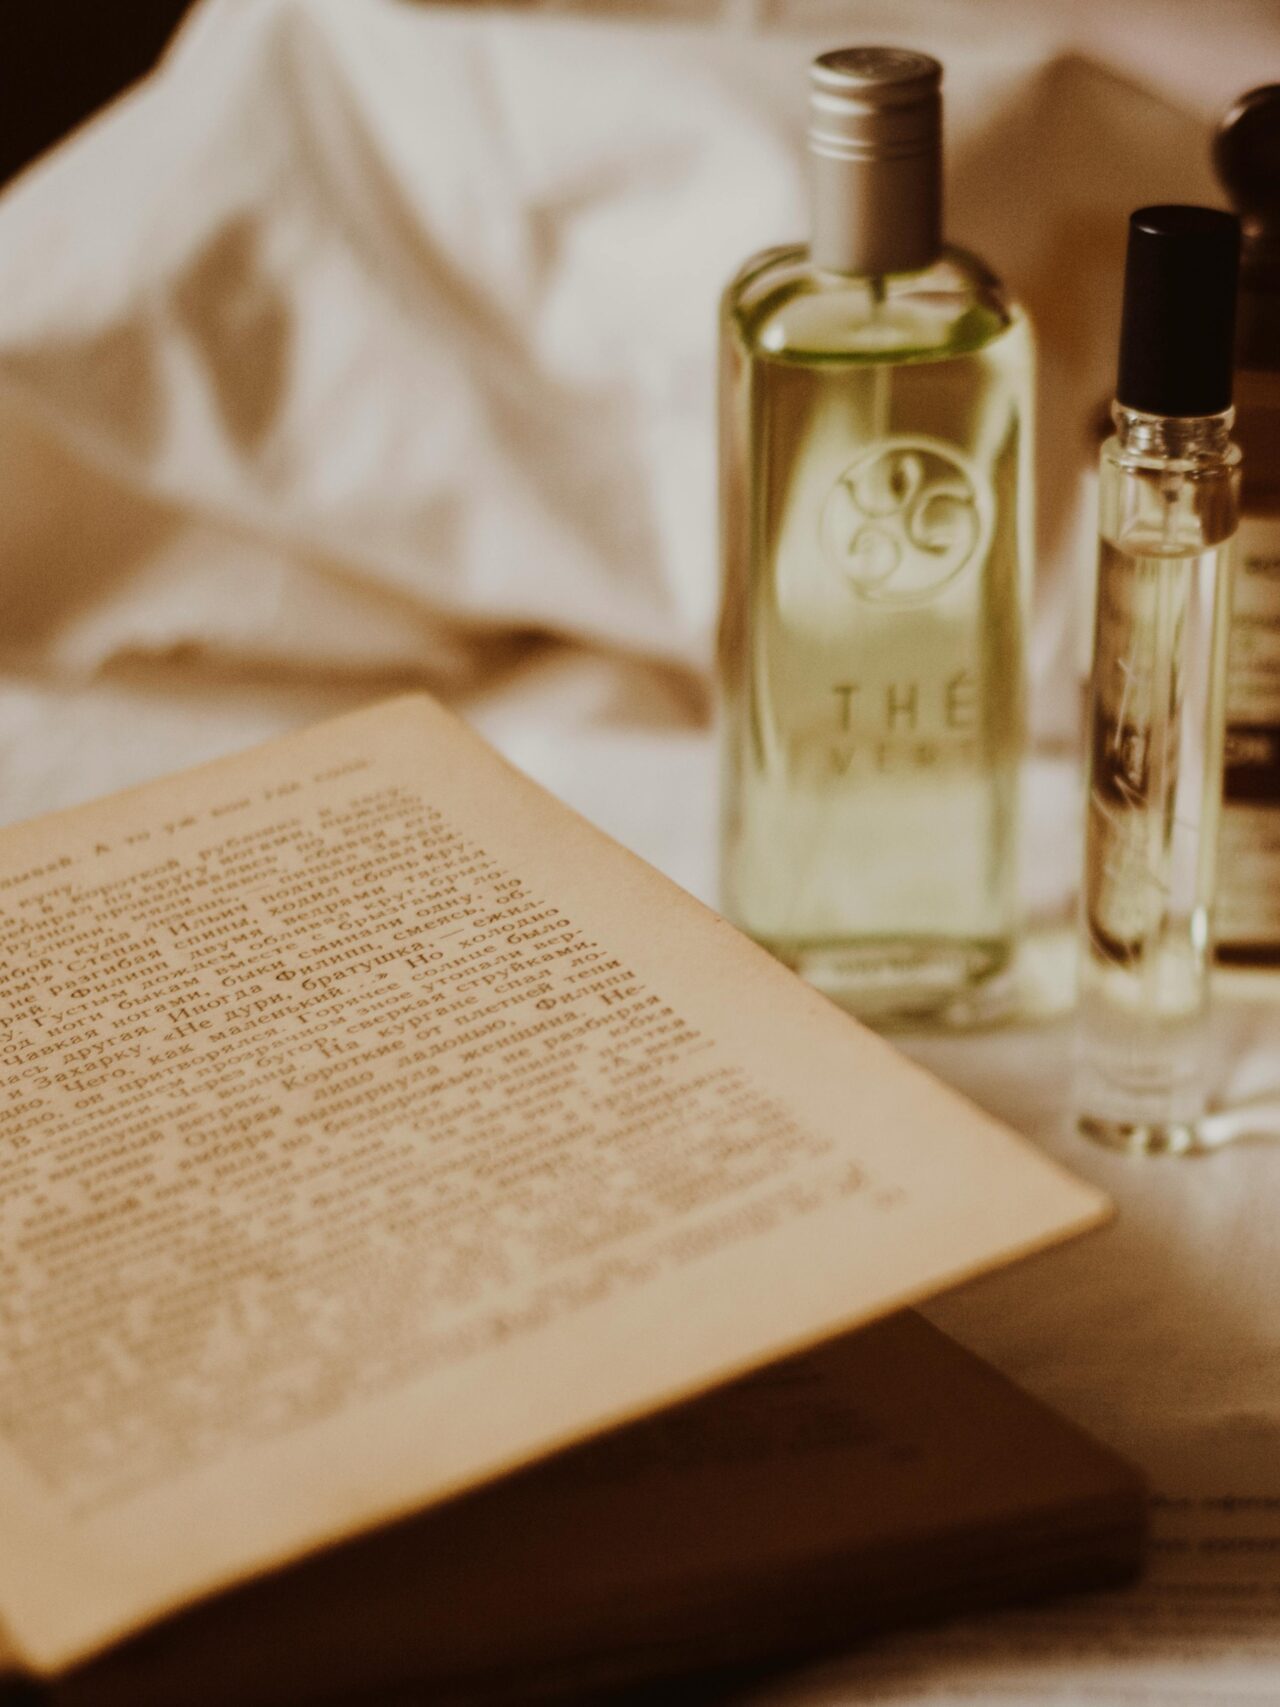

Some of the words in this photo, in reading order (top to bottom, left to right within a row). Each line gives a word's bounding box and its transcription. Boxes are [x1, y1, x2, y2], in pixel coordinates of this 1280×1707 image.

[832, 669, 979, 731] THÉ
[1, 1027, 100, 1066] Чавкая
[110, 989, 211, 1029] ногами,
[219, 958, 287, 988] быки
[296, 916, 404, 960] сминали
[492, 877, 522, 893] но
[30, 987, 129, 1028] Густым
[140, 950, 238, 991] дождем
[247, 910, 351, 951] обливал
[45, 1010, 104, 1038] ноги
[116, 975, 201, 1011] быкам
[212, 941, 299, 976] вместе
[310, 932, 326, 941] с
[336, 884, 459, 931] брызгами
[47, 948, 163, 998] разгибая
[172, 916, 259, 950] спины,
[266, 884, 340, 918] ходил
[65, 935, 158, 973] Степан
[166, 902, 249, 937] Ильич
[259, 844, 417, 905] подталкивал
[68, 960, 169, 999] Филипп
[188, 926, 265, 961] двумя
[280, 884, 387, 927] ведрами
[402, 847, 487, 884] таскал
[31, 1042, 152, 1091] Захарку.
[162, 1018, 213, 1041] «Не
[223, 992, 293, 1023] дури,
[300, 940, 435, 992] братушка,
[61, 1024, 157, 1066] другая.
[166, 983, 263, 1024] Иногда
[273, 942, 384, 982] Филипп,
[391, 906, 486, 941] смеясь,
[494, 887, 533, 905] об-
[73, 1091, 105, 1110] он
[116, 1026, 287, 1094] притворялся.
[294, 981, 402, 1025] Горячее
[409, 944, 498, 982] солнце
[505, 917, 571, 945] было
[146, 1042, 195, 1066] как
[403, 950, 444, 970] Но
[457, 907, 560, 950] холодно
[194, 1014, 348, 1079] прозрачном
[355, 990, 414, 1017] зное
[419, 948, 524, 994] утопали
[531, 928, 584, 951] вер-
[254, 1035, 339, 1069] бугор,
[344, 990, 447, 1035] сверкая
[454, 939, 598, 993] струйками,
[279, 1038, 407, 1093] Короткие
[414, 1024, 442, 1041] от
[452, 980, 555, 1027] плетней
[562, 958, 622, 984] тени
[317, 1039, 360, 1060] На
[375, 994, 479, 1039] кургане
[492, 967, 553, 994] спал
[569, 949, 608, 968] ло-
[533, 968, 637, 1011] Филипп
[541, 993, 662, 1052] разбирая
[598, 983, 646, 1006] Не-
